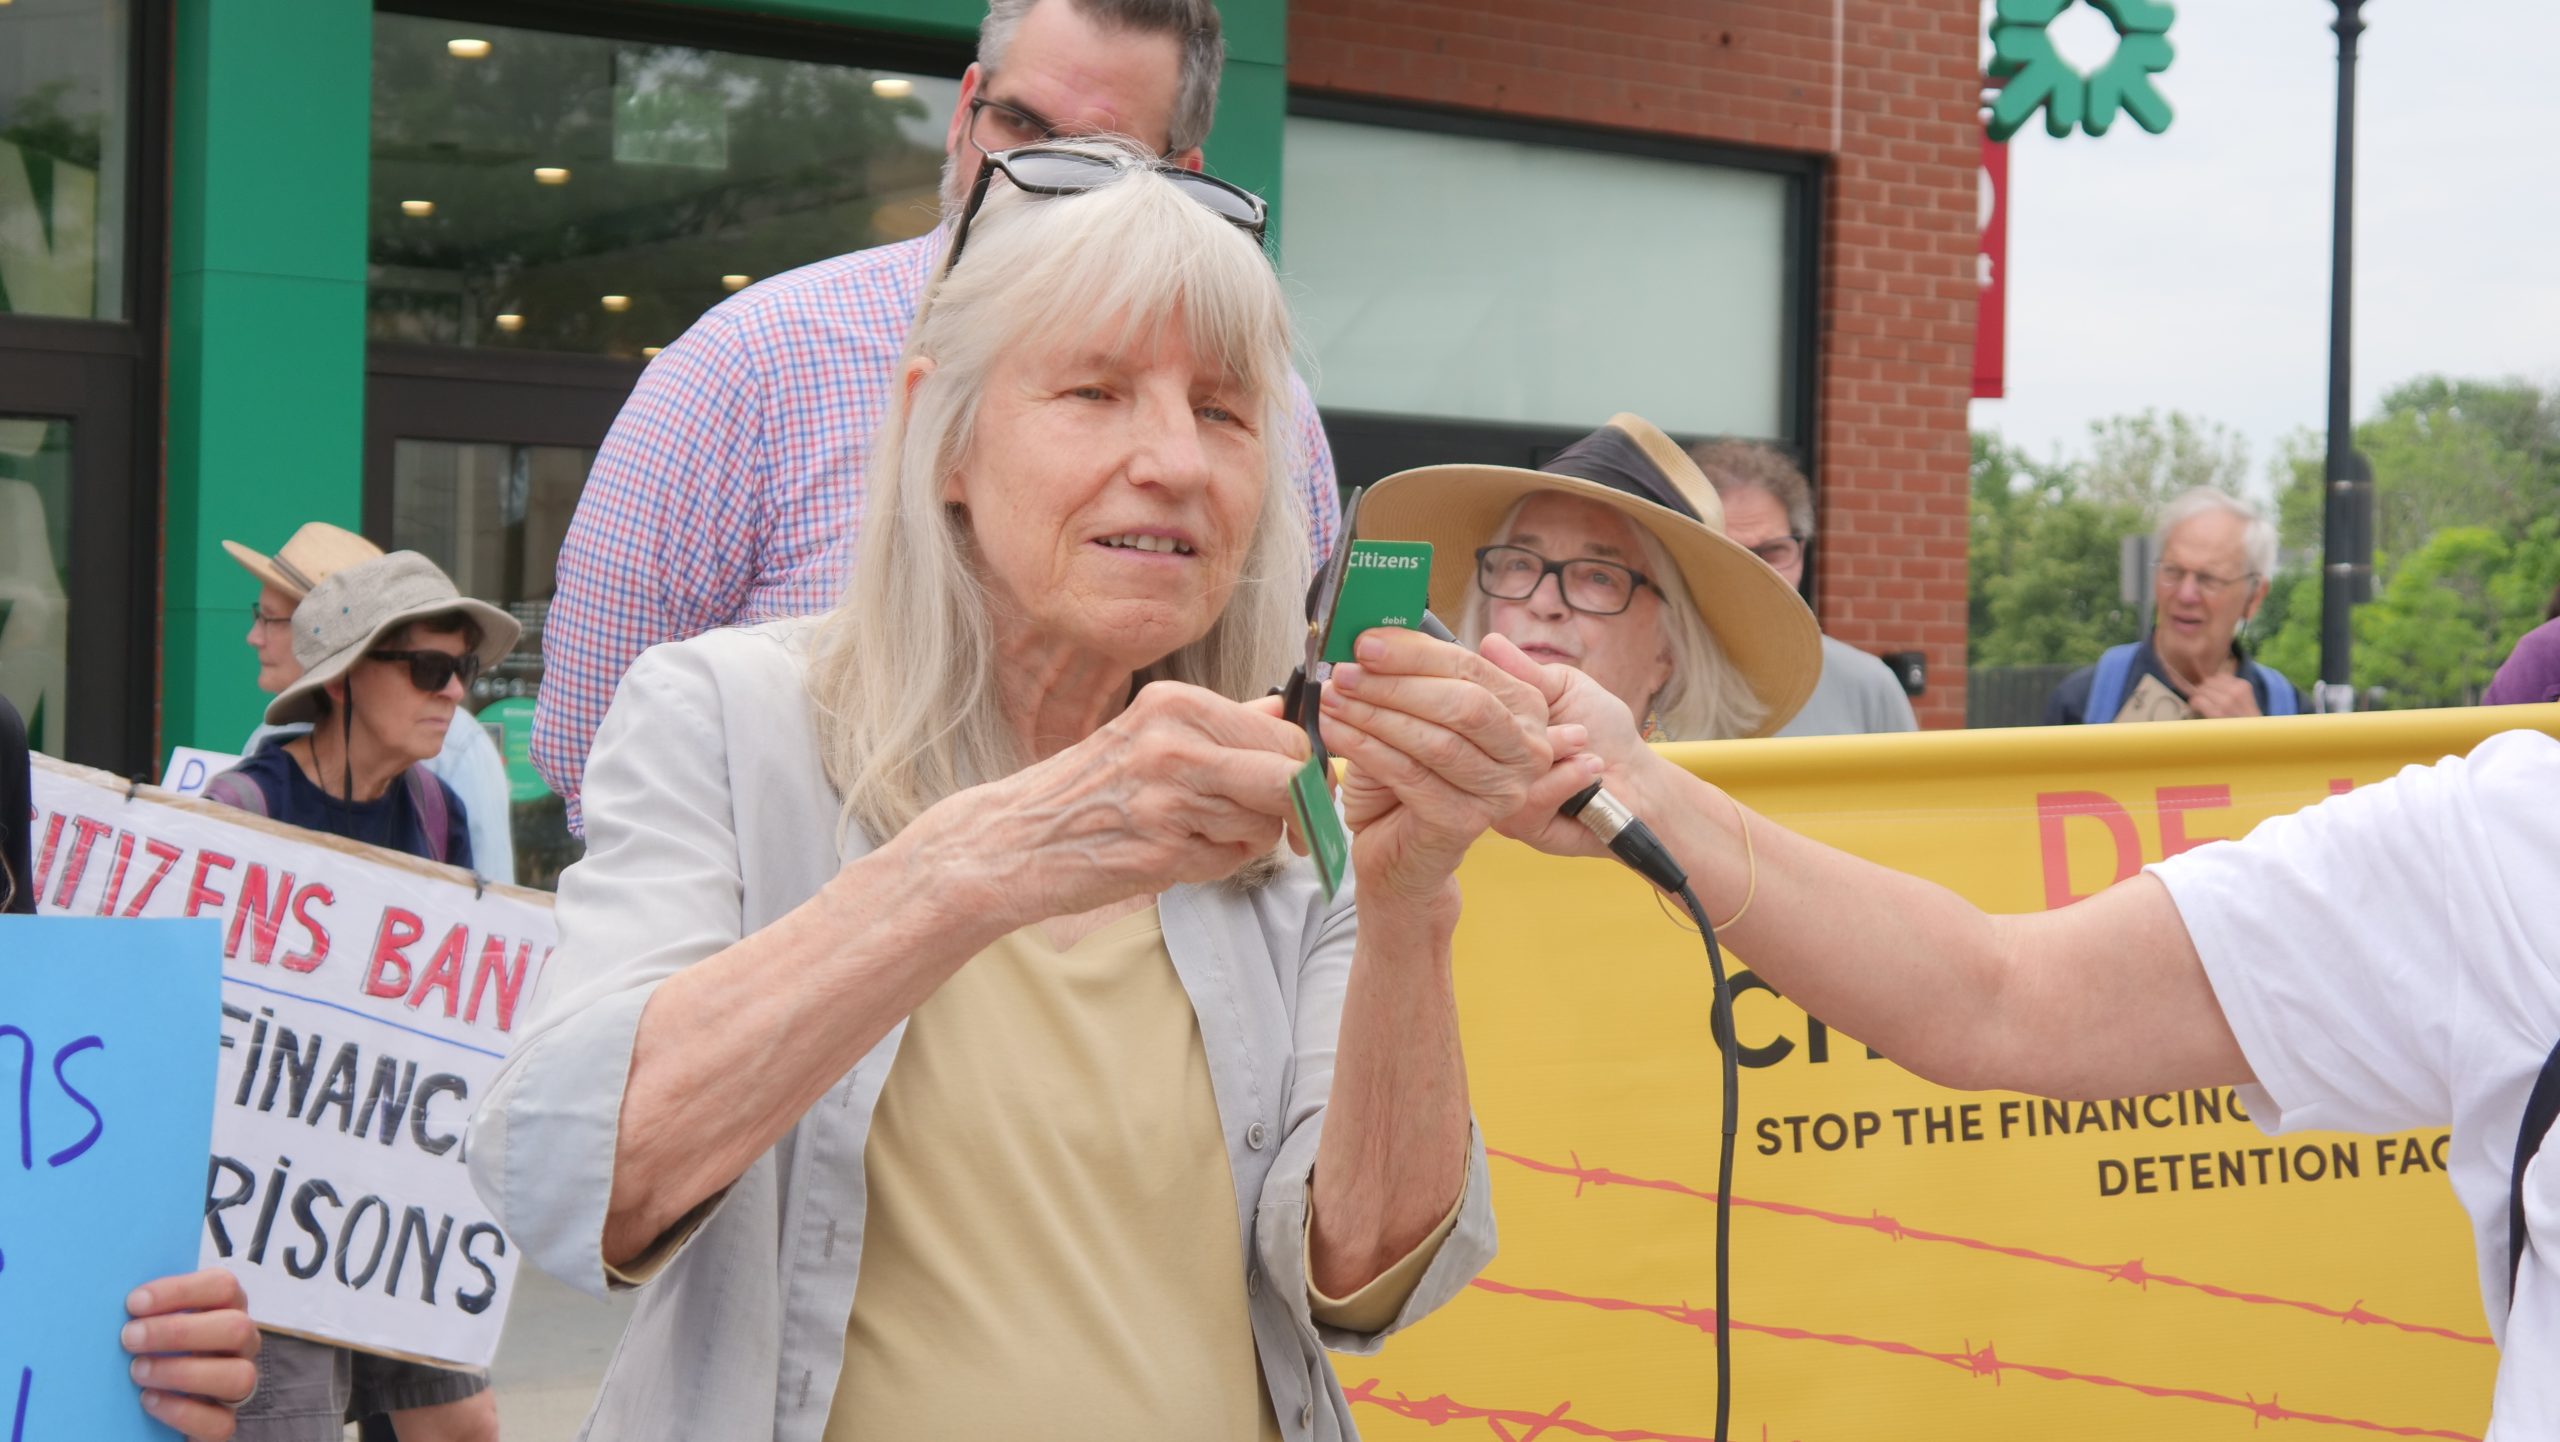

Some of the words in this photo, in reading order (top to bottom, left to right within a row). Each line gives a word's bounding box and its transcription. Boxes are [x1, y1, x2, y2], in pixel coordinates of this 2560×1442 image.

[1381, 616, 1408, 625] debit
[31, 804, 335, 974] ITIZENS
[360, 905, 553, 1032] BAN
[220, 1001, 472, 1164] FINANC
[1756, 1113, 1881, 1156] STOP
[1892, 1103, 1984, 1146] THE
[2098, 1141, 2360, 1197] DETENTION
